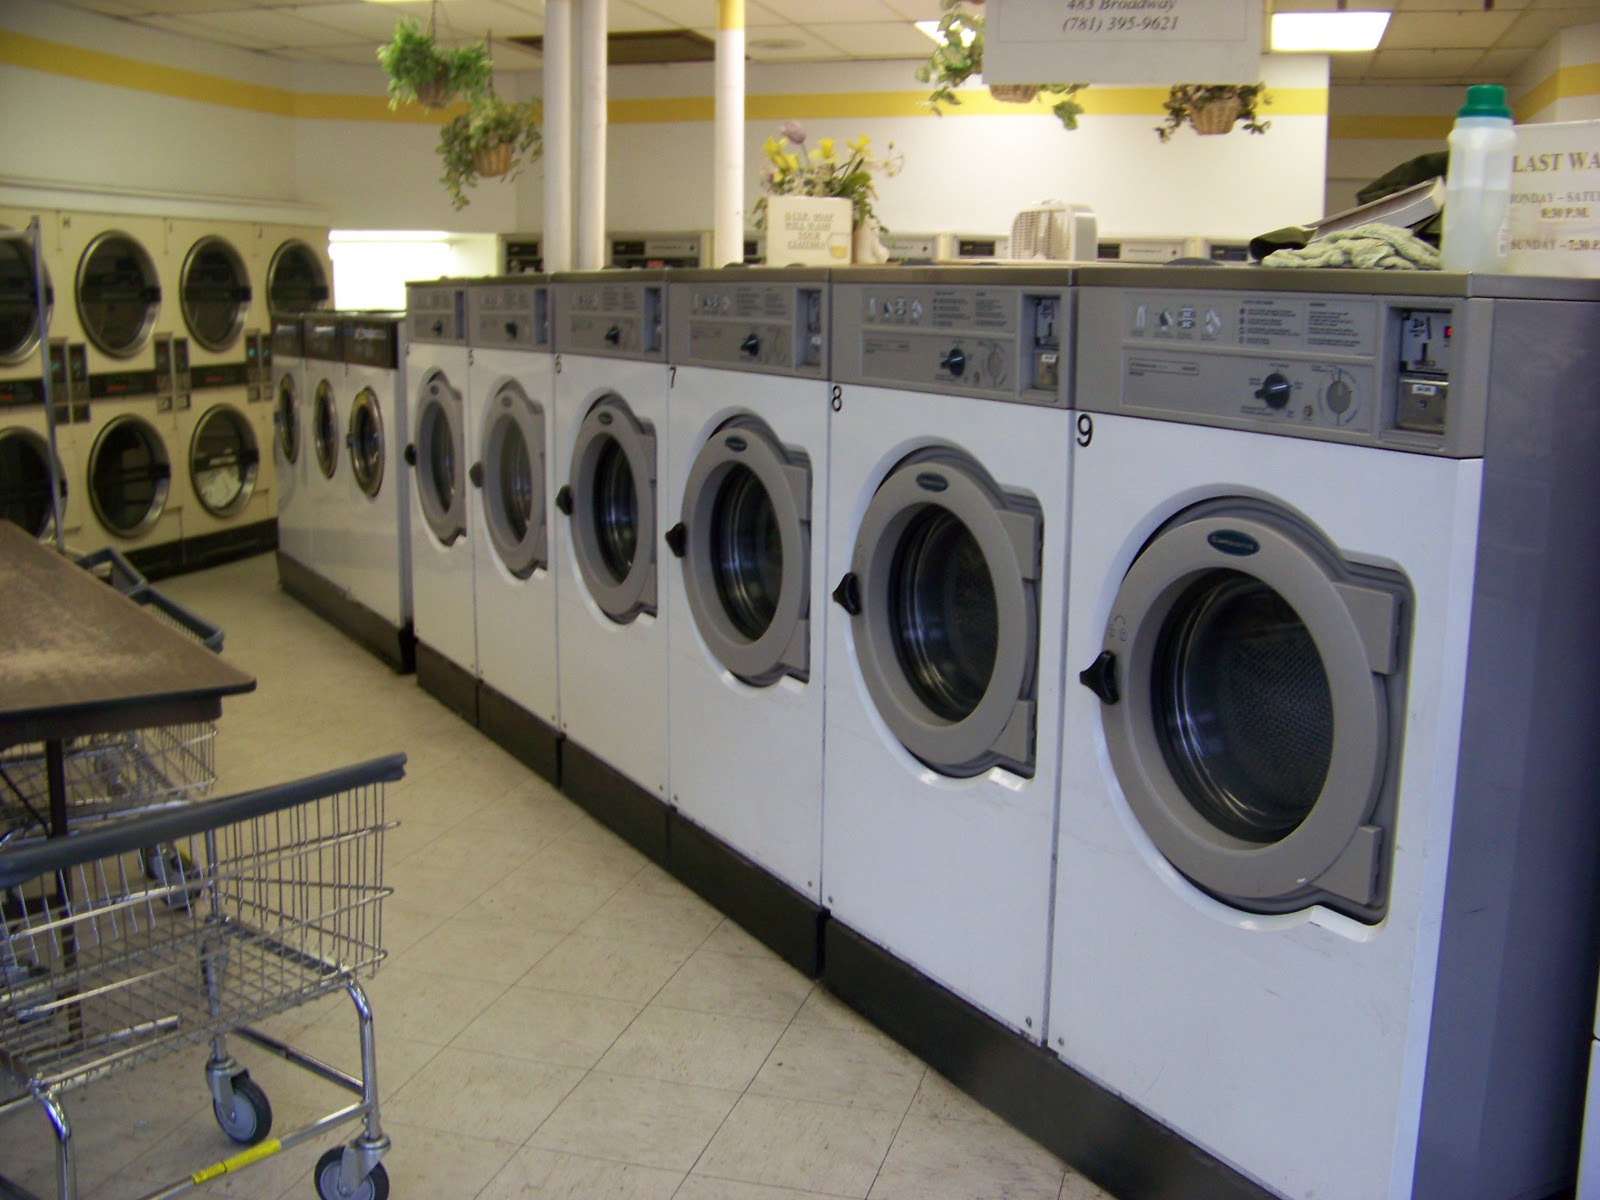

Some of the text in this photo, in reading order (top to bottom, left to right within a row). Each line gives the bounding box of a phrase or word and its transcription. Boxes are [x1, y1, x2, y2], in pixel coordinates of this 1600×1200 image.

[1062, 15, 1179, 32] (781) 395-9621
[1512, 153, 1563, 173] LAST
[669, 366, 677, 389] 7
[831, 385, 842, 412] 8
[1077, 413, 1094, 448] 9
